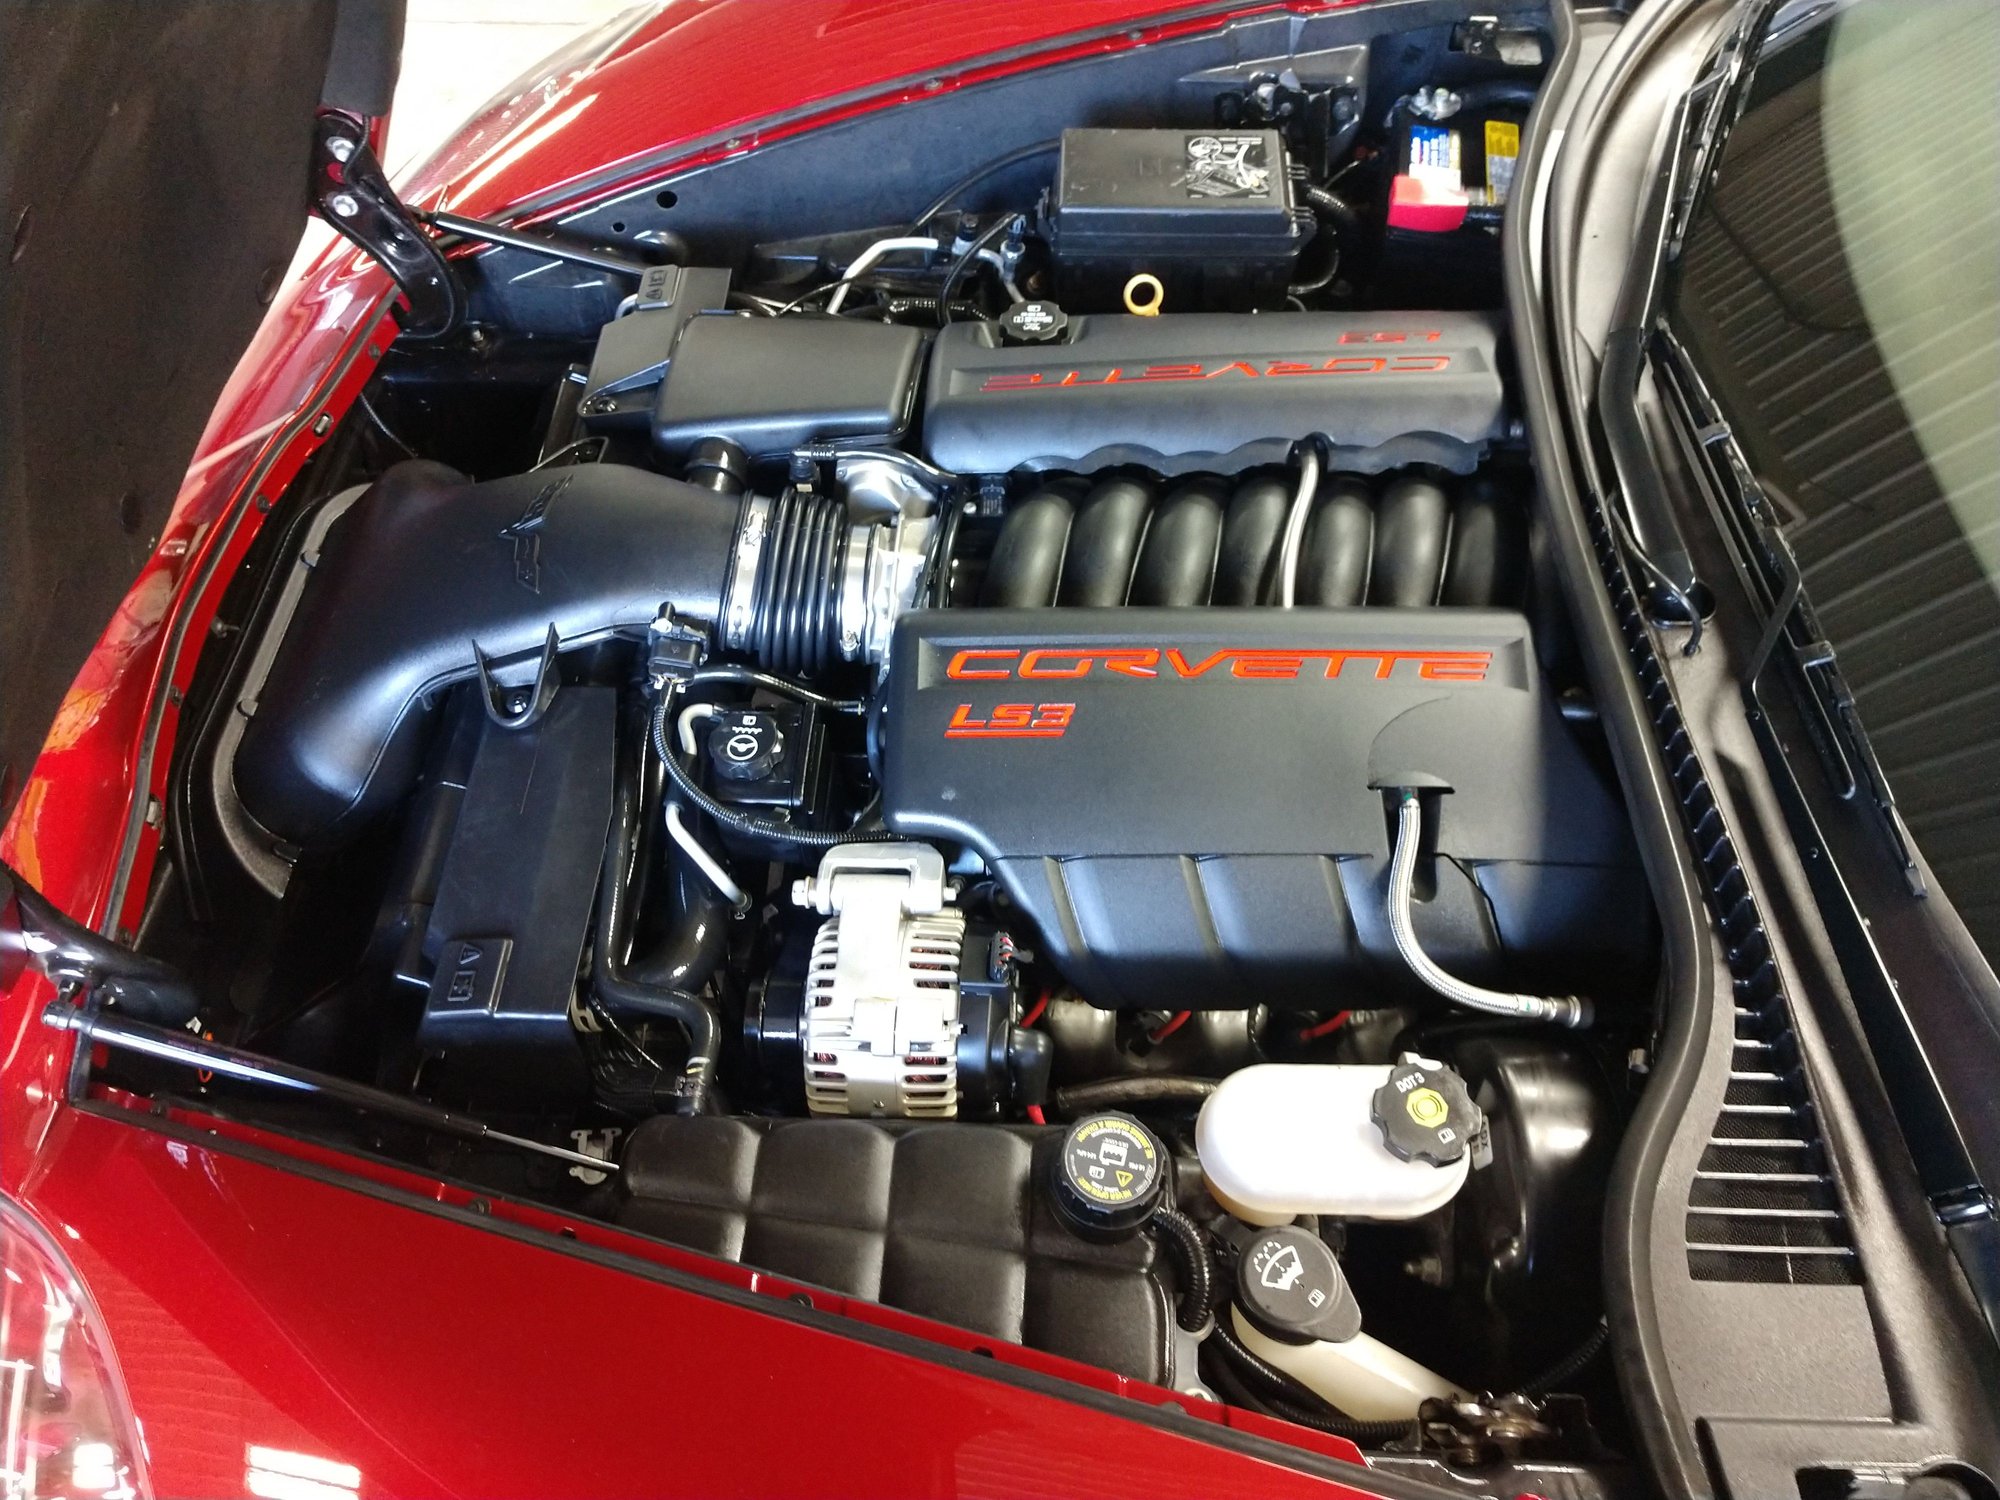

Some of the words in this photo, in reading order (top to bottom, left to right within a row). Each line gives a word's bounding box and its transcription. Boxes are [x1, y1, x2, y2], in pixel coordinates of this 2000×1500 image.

[1336, 330, 1443, 346] LS3
[979, 355, 1451, 391] CORVETTE
[945, 647, 1494, 680] CORVETTE
[947, 702, 1076, 730] LS3
[1395, 1074, 1418, 1093] DOT
[1414, 1071, 1426, 1084] 3
